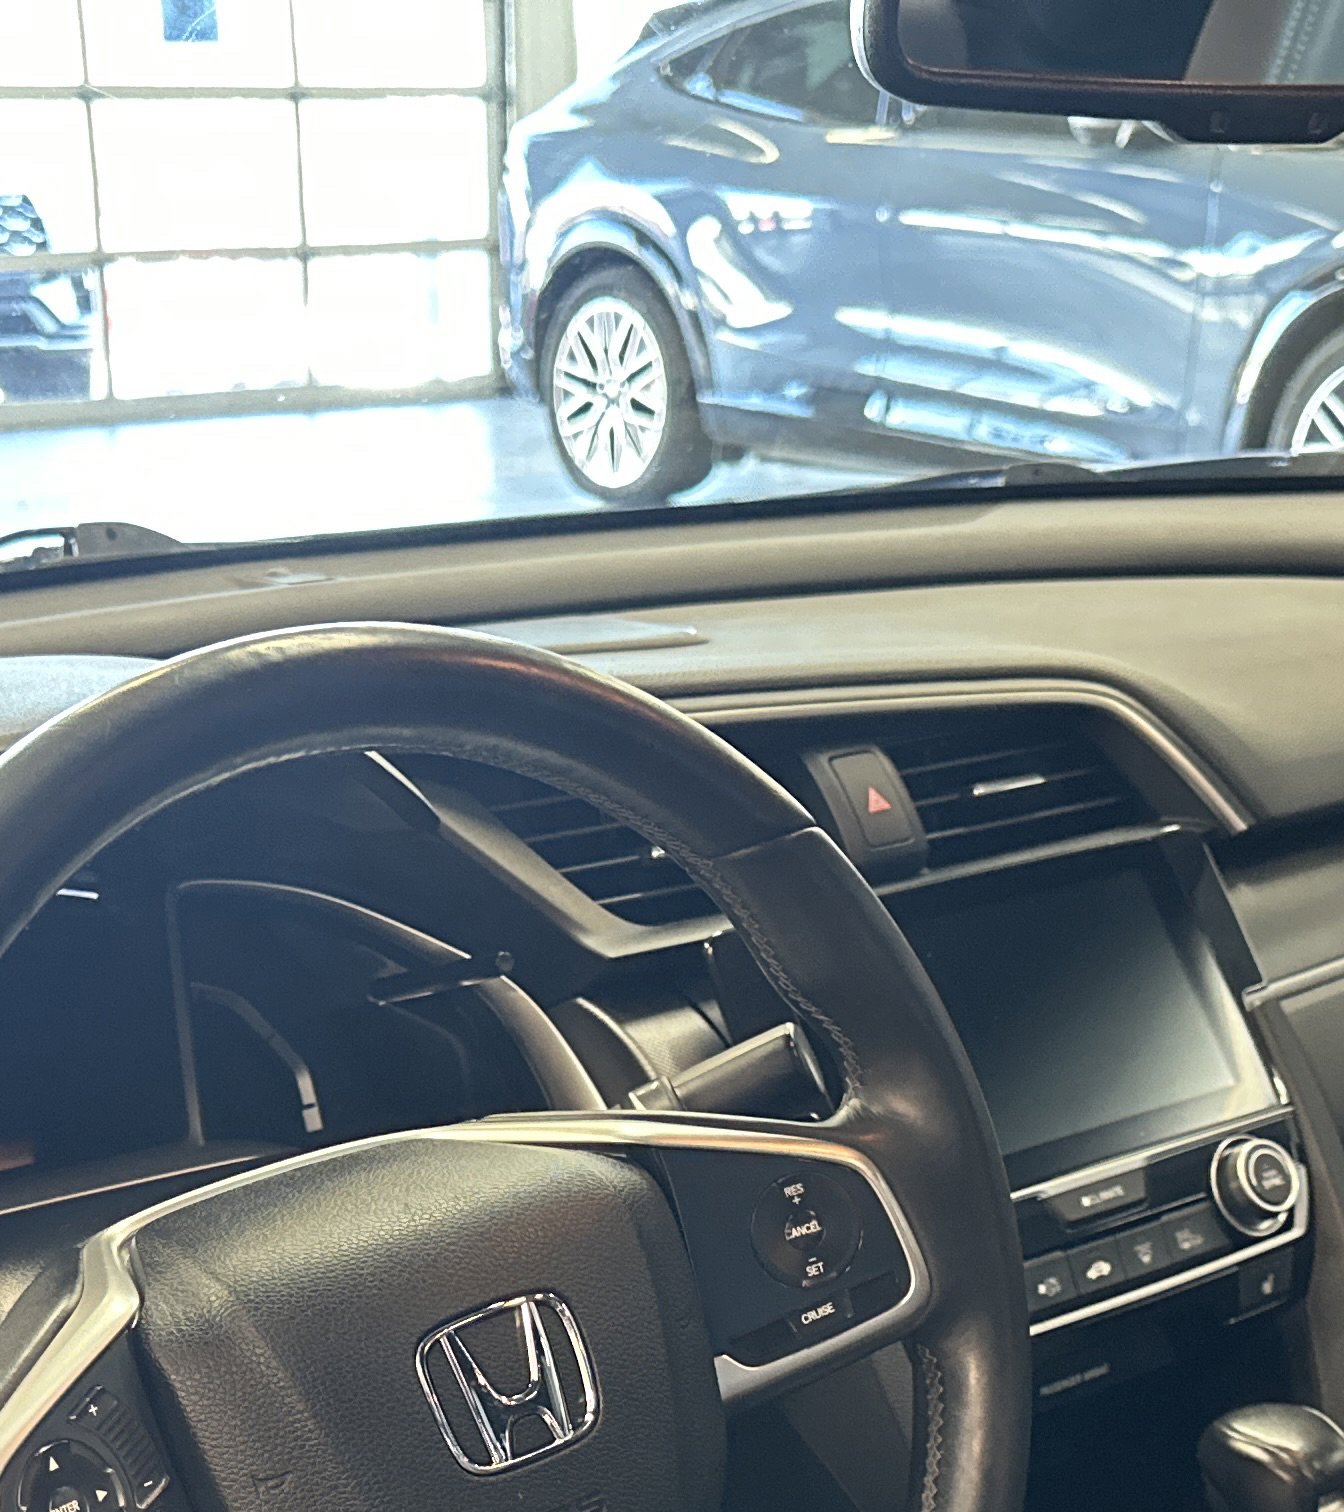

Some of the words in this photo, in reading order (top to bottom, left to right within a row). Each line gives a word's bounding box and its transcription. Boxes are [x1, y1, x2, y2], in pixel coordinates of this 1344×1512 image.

[783, 1183, 805, 1198] RES
[785, 1220, 822, 1240] CANCEL
[806, 1262, 824, 1277] SET
[801, 1302, 836, 1325] CRUISE
